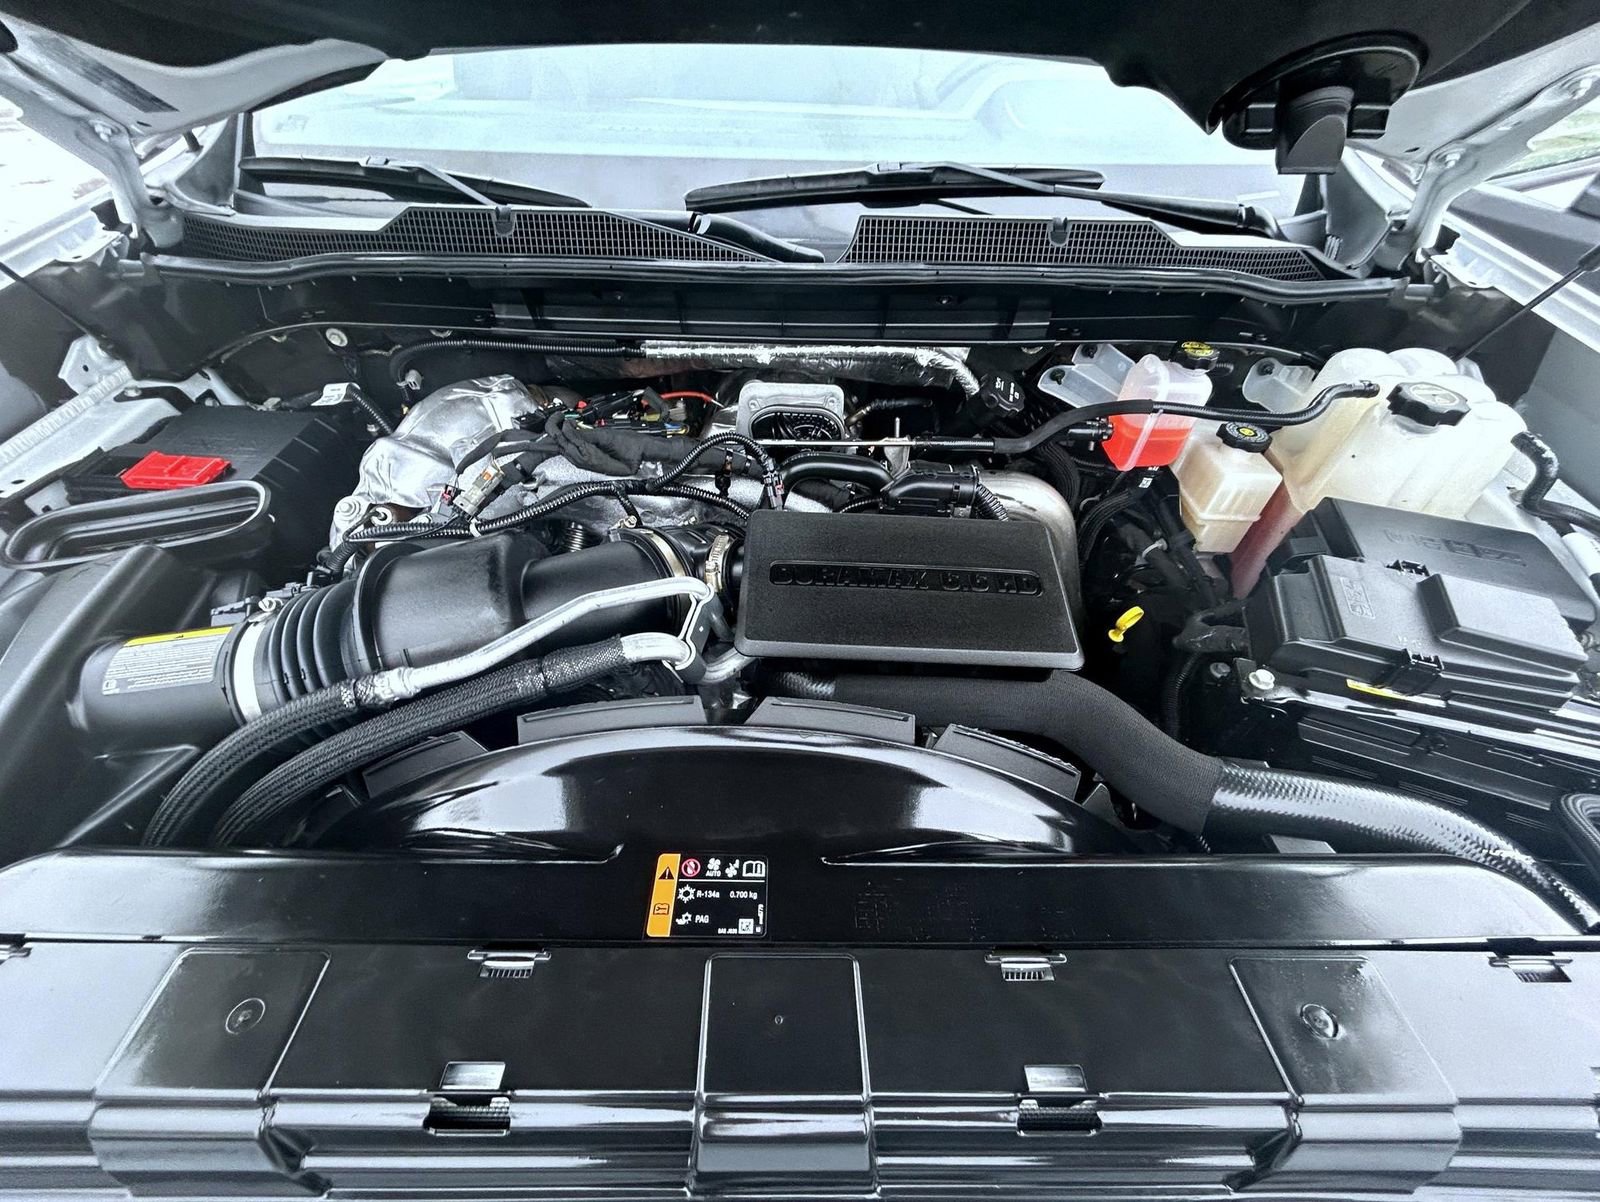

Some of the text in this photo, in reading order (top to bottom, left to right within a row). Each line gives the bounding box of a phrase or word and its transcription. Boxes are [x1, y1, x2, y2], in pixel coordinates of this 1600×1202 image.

[696, 890, 758, 900] R-134a 0.700 kg
[695, 915, 709, 923] PAG
